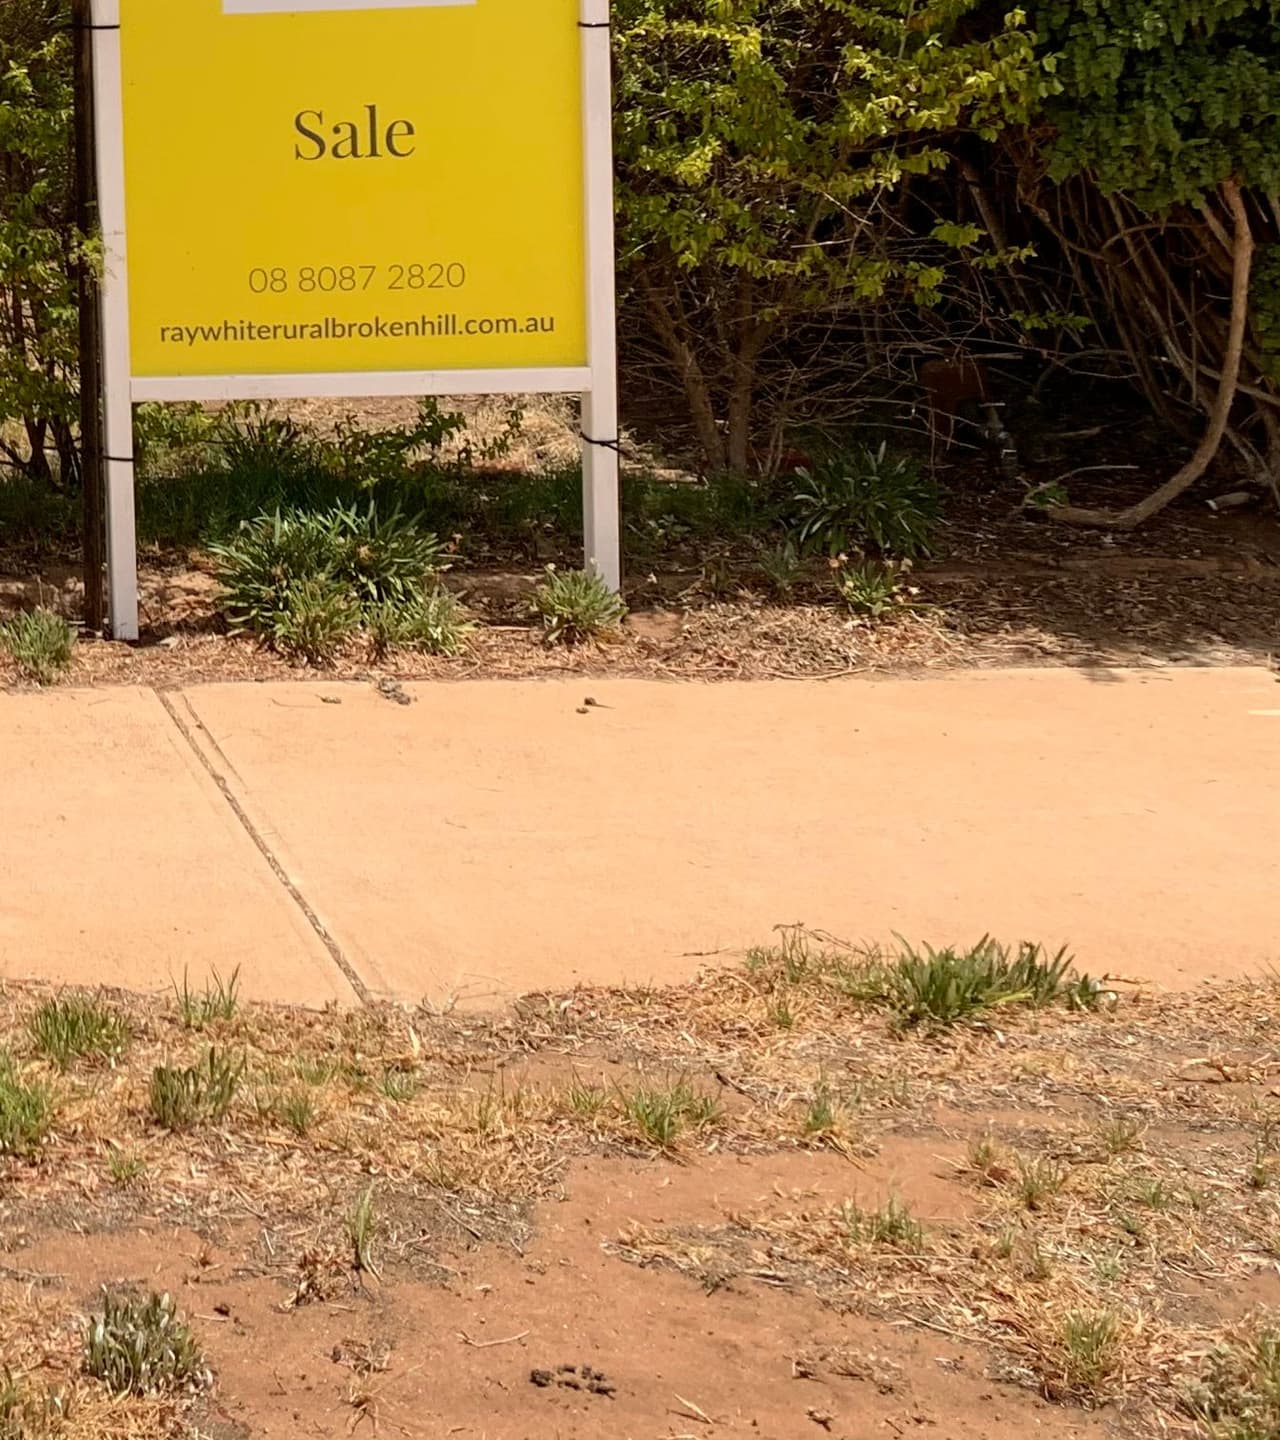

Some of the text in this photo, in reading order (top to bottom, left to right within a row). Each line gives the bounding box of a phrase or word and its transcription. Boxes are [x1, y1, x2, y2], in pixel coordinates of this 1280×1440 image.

[293, 104, 417, 161] Sale
[248, 262, 466, 294] 08 8087 2820
[159, 313, 556, 347] raywhiteruralbrokenhill.com.au
